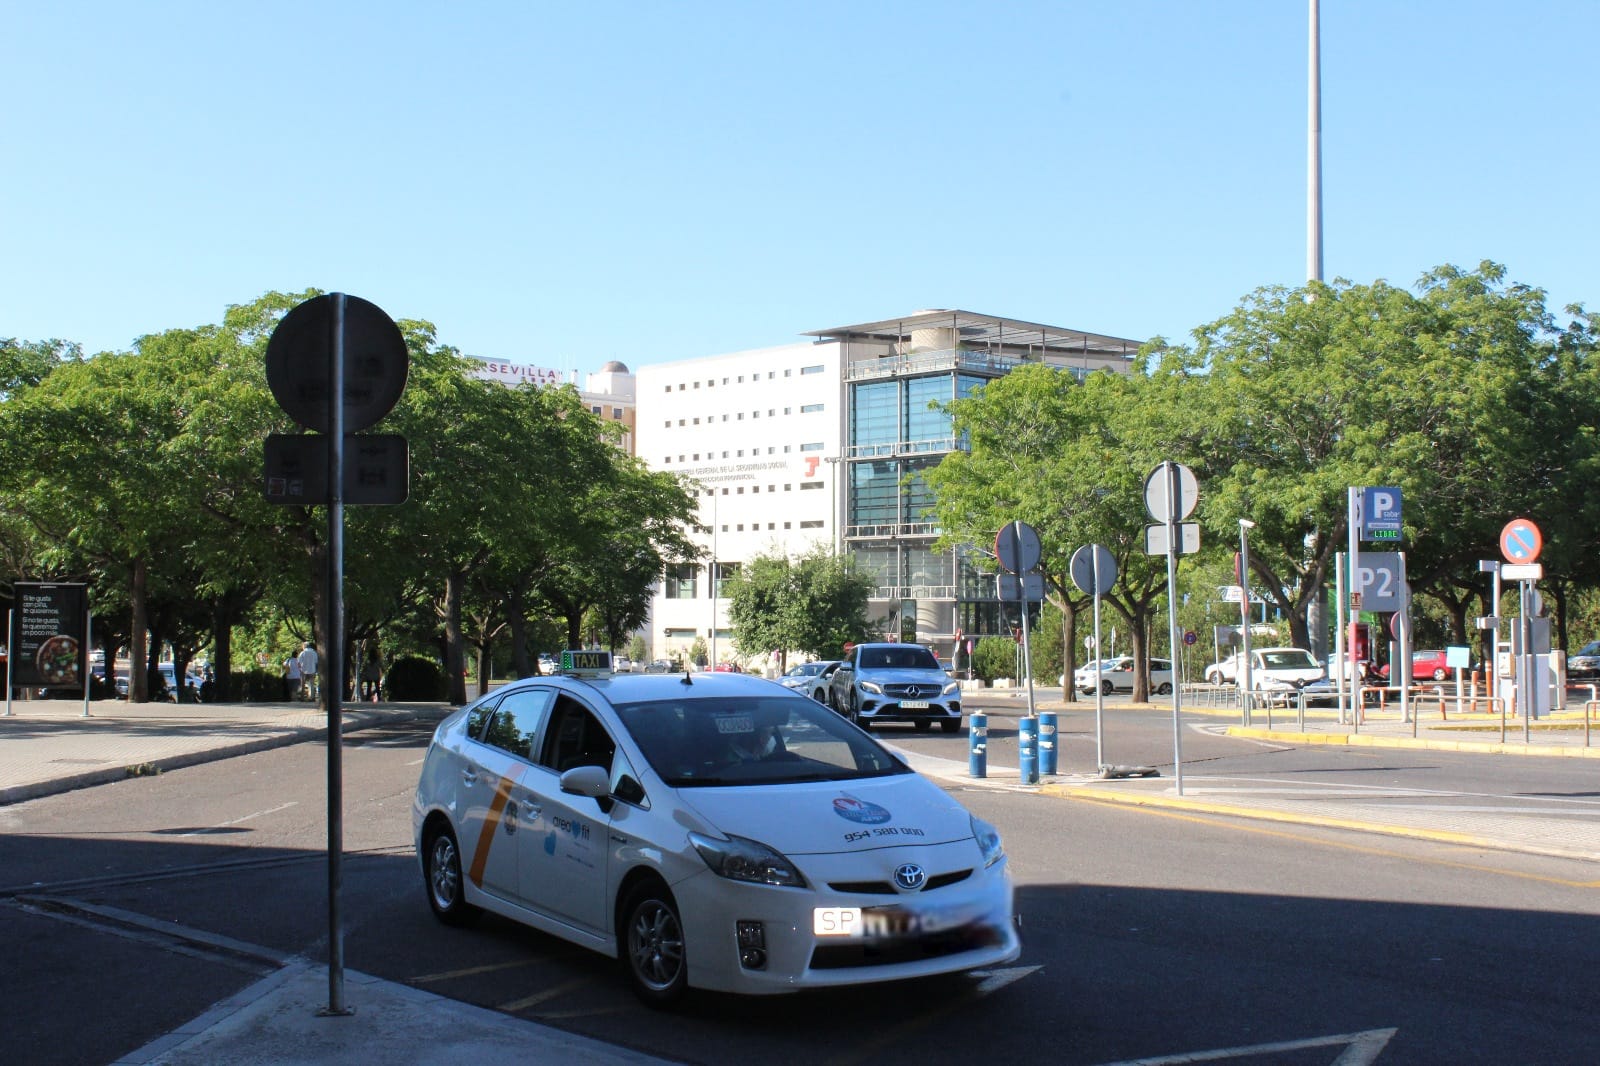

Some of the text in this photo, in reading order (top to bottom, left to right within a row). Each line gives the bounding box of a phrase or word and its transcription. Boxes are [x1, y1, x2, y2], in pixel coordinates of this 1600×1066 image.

[489, 363, 556, 378] SEVILLA
[1374, 492, 1393, 519] P
[1374, 530, 1398, 538] LIBRE
[1358, 567, 1392, 597] P2
[574, 654, 600, 668] TAXI
[552, 816, 590, 840] area fit
[844, 827, 925, 843] 954 580 000
[822, 911, 854, 931] SP
